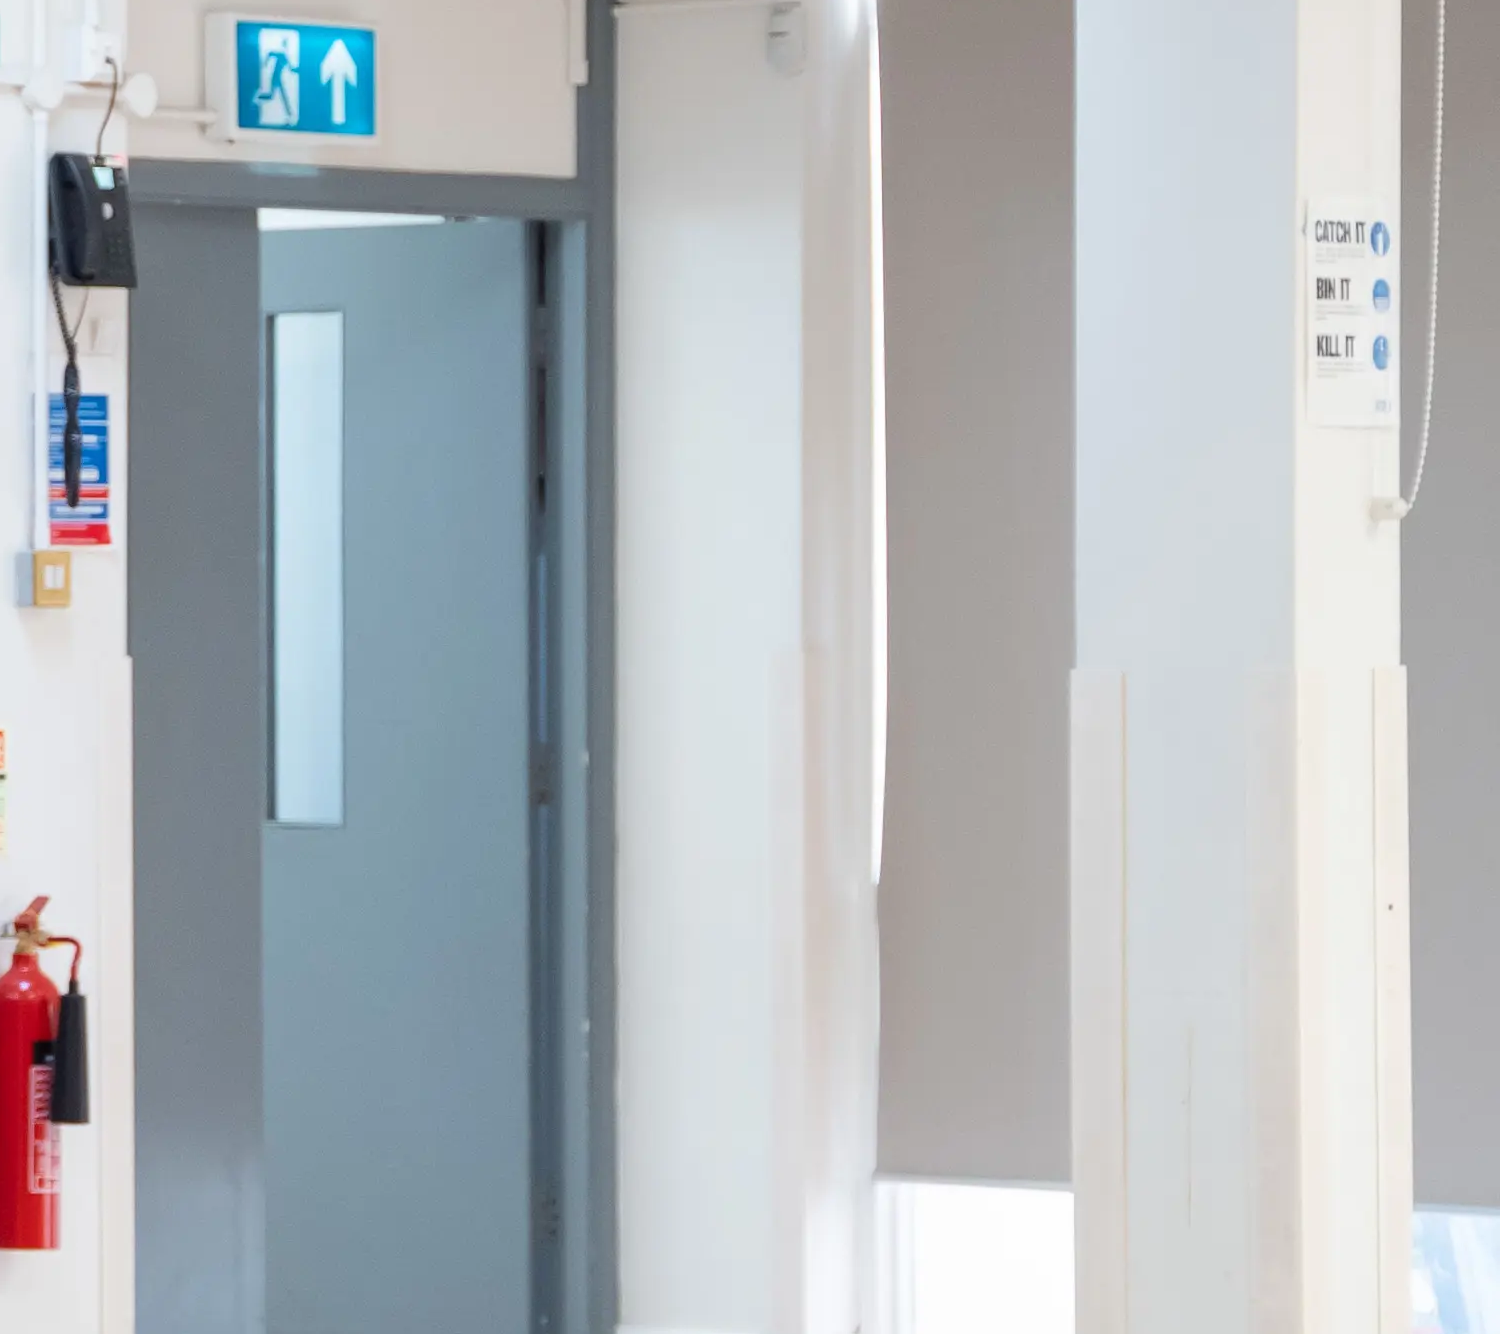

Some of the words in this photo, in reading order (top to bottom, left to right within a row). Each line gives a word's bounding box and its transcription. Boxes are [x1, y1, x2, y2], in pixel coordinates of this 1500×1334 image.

[1315, 220, 1351, 244] CATCH
[1355, 221, 1367, 244] IT
[1316, 277, 1336, 301] BIN
[1340, 278, 1351, 300] IT
[1316, 335, 1341, 358] KILL
[1345, 335, 1356, 357] IT
